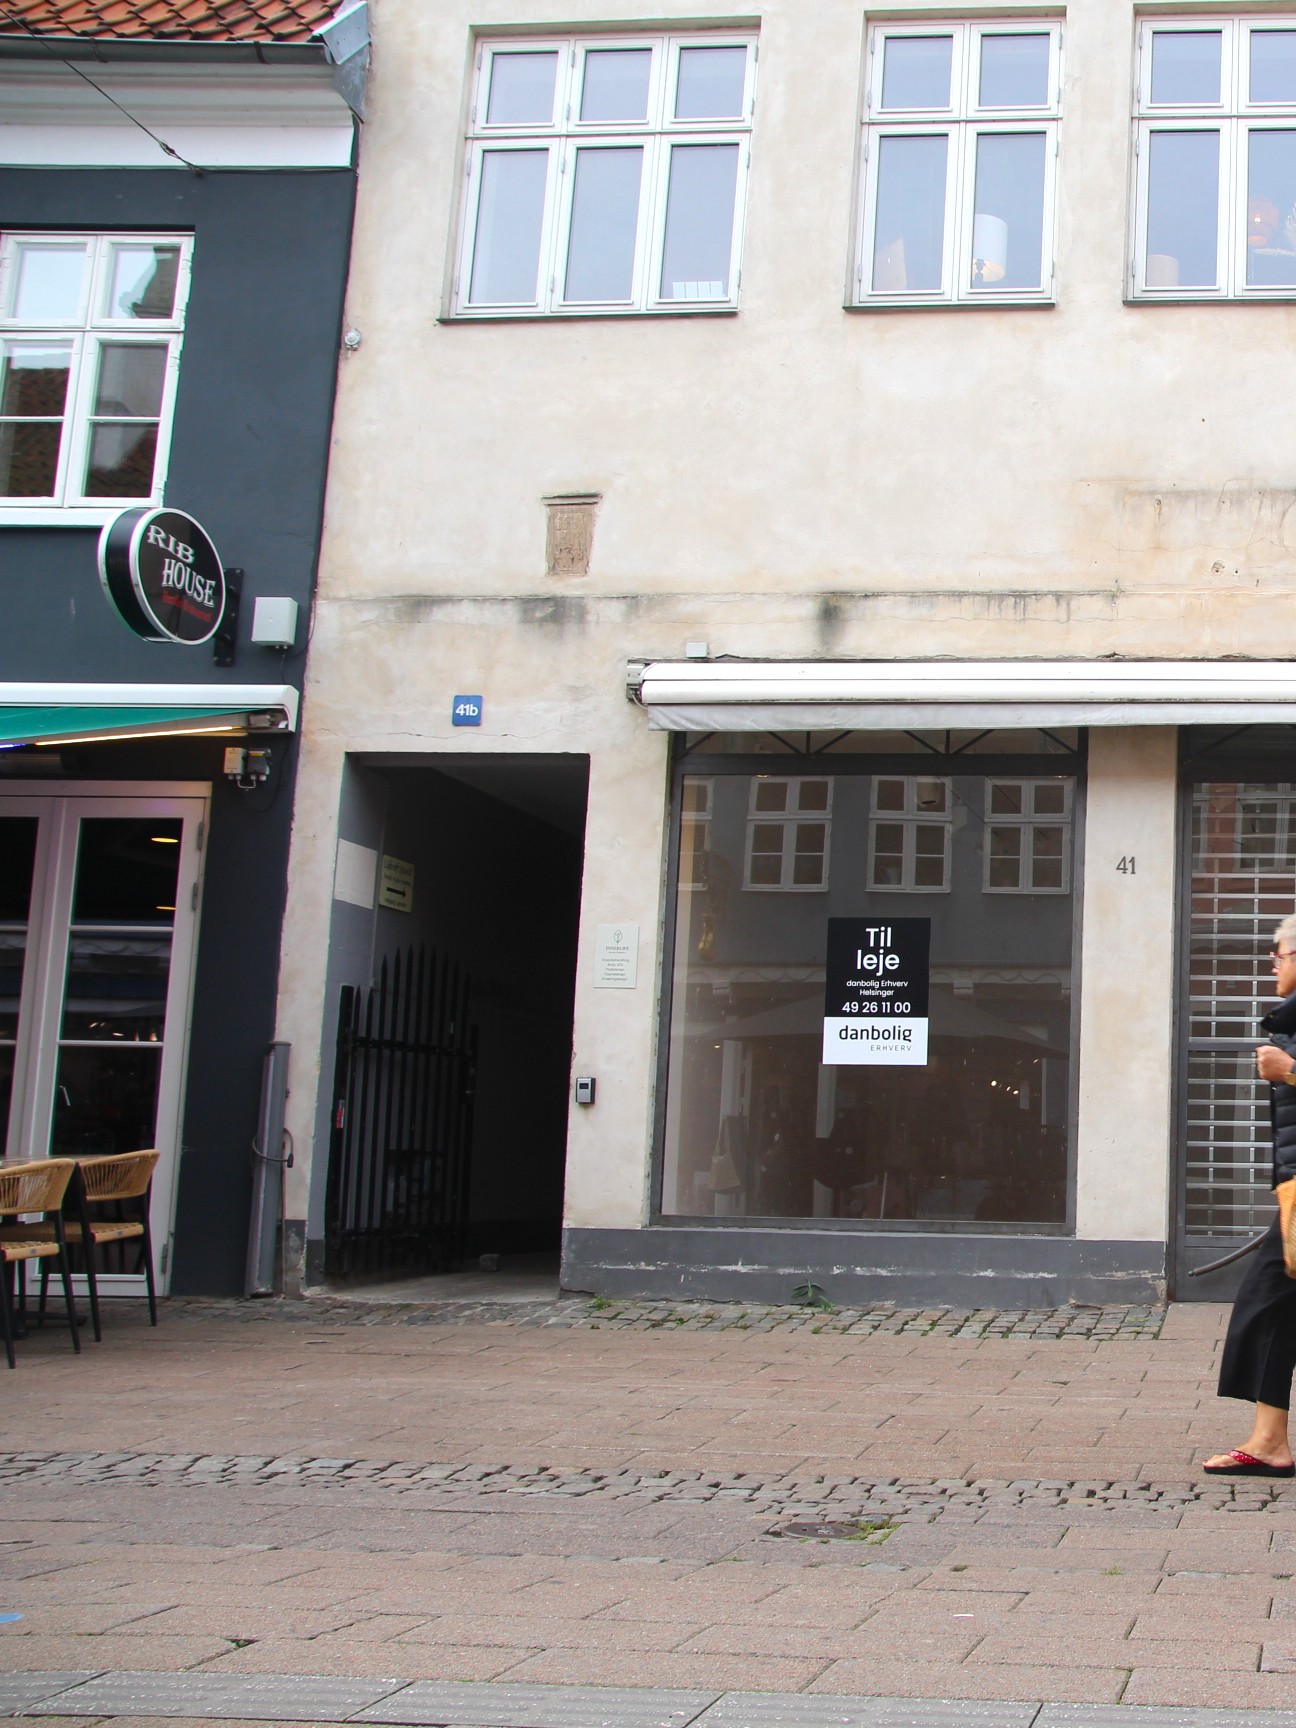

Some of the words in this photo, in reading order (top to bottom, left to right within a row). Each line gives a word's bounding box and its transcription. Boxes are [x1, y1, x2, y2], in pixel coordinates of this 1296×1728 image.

[147, 524, 195, 564] RIB
[161, 558, 216, 607] HOUSE
[455, 703, 479, 716] 41b
[1115, 856, 1136, 875] 41
[866, 926, 892, 947] Til
[856, 949, 900, 976] leje
[846, 980, 879, 988] danbolig
[860, 989, 894, 997] Helsingør
[842, 1002, 858, 1013] 49
[862, 1002, 878, 1013] 26
[882, 1002, 890, 1013] 11
[894, 1002, 911, 1013] 00
[839, 1025, 912, 1042] danbolig
